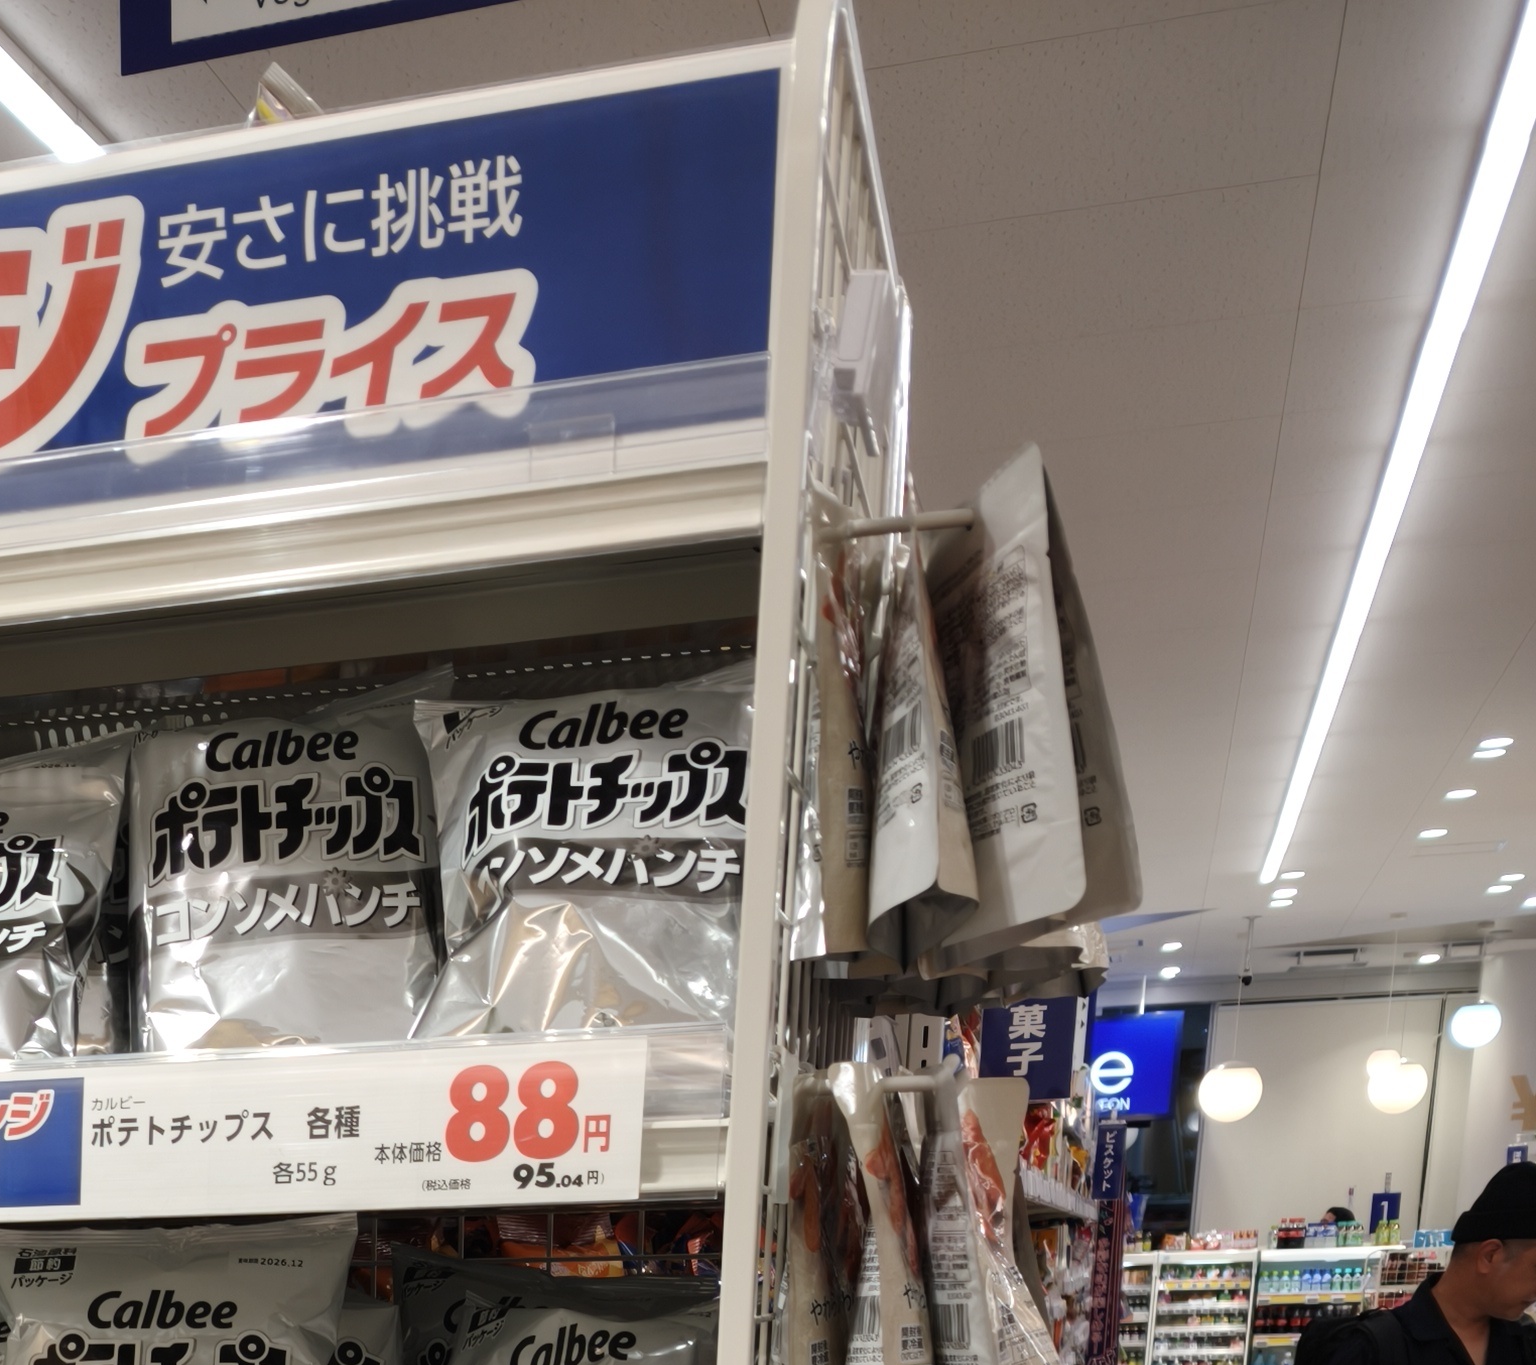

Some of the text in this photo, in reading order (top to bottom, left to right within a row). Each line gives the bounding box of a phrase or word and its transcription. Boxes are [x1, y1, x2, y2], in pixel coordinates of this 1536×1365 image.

[157, 155, 523, 289] 安さに挑戦
[126, 270, 537, 461] プライス
[518, 702, 689, 751] Calbee
[204, 728, 359, 772] Calbee
[148, 762, 426, 888] ポテトチップス
[155, 879, 422, 947] コンソメパンチ
[1006, 1004, 1047, 1077] 菓子
[91, 1095, 146, 1112] カルビー
[91, 1104, 361, 1148] ポテトチップス 各種
[374, 1140, 443, 1165] 本体価格
[1102, 1131, 1118, 1192] ビスケット
[10, 1272, 73, 1289] パッケージ
[29, 1258, 61, 1271] 節約
[86, 1290, 237, 1330] Calbee
